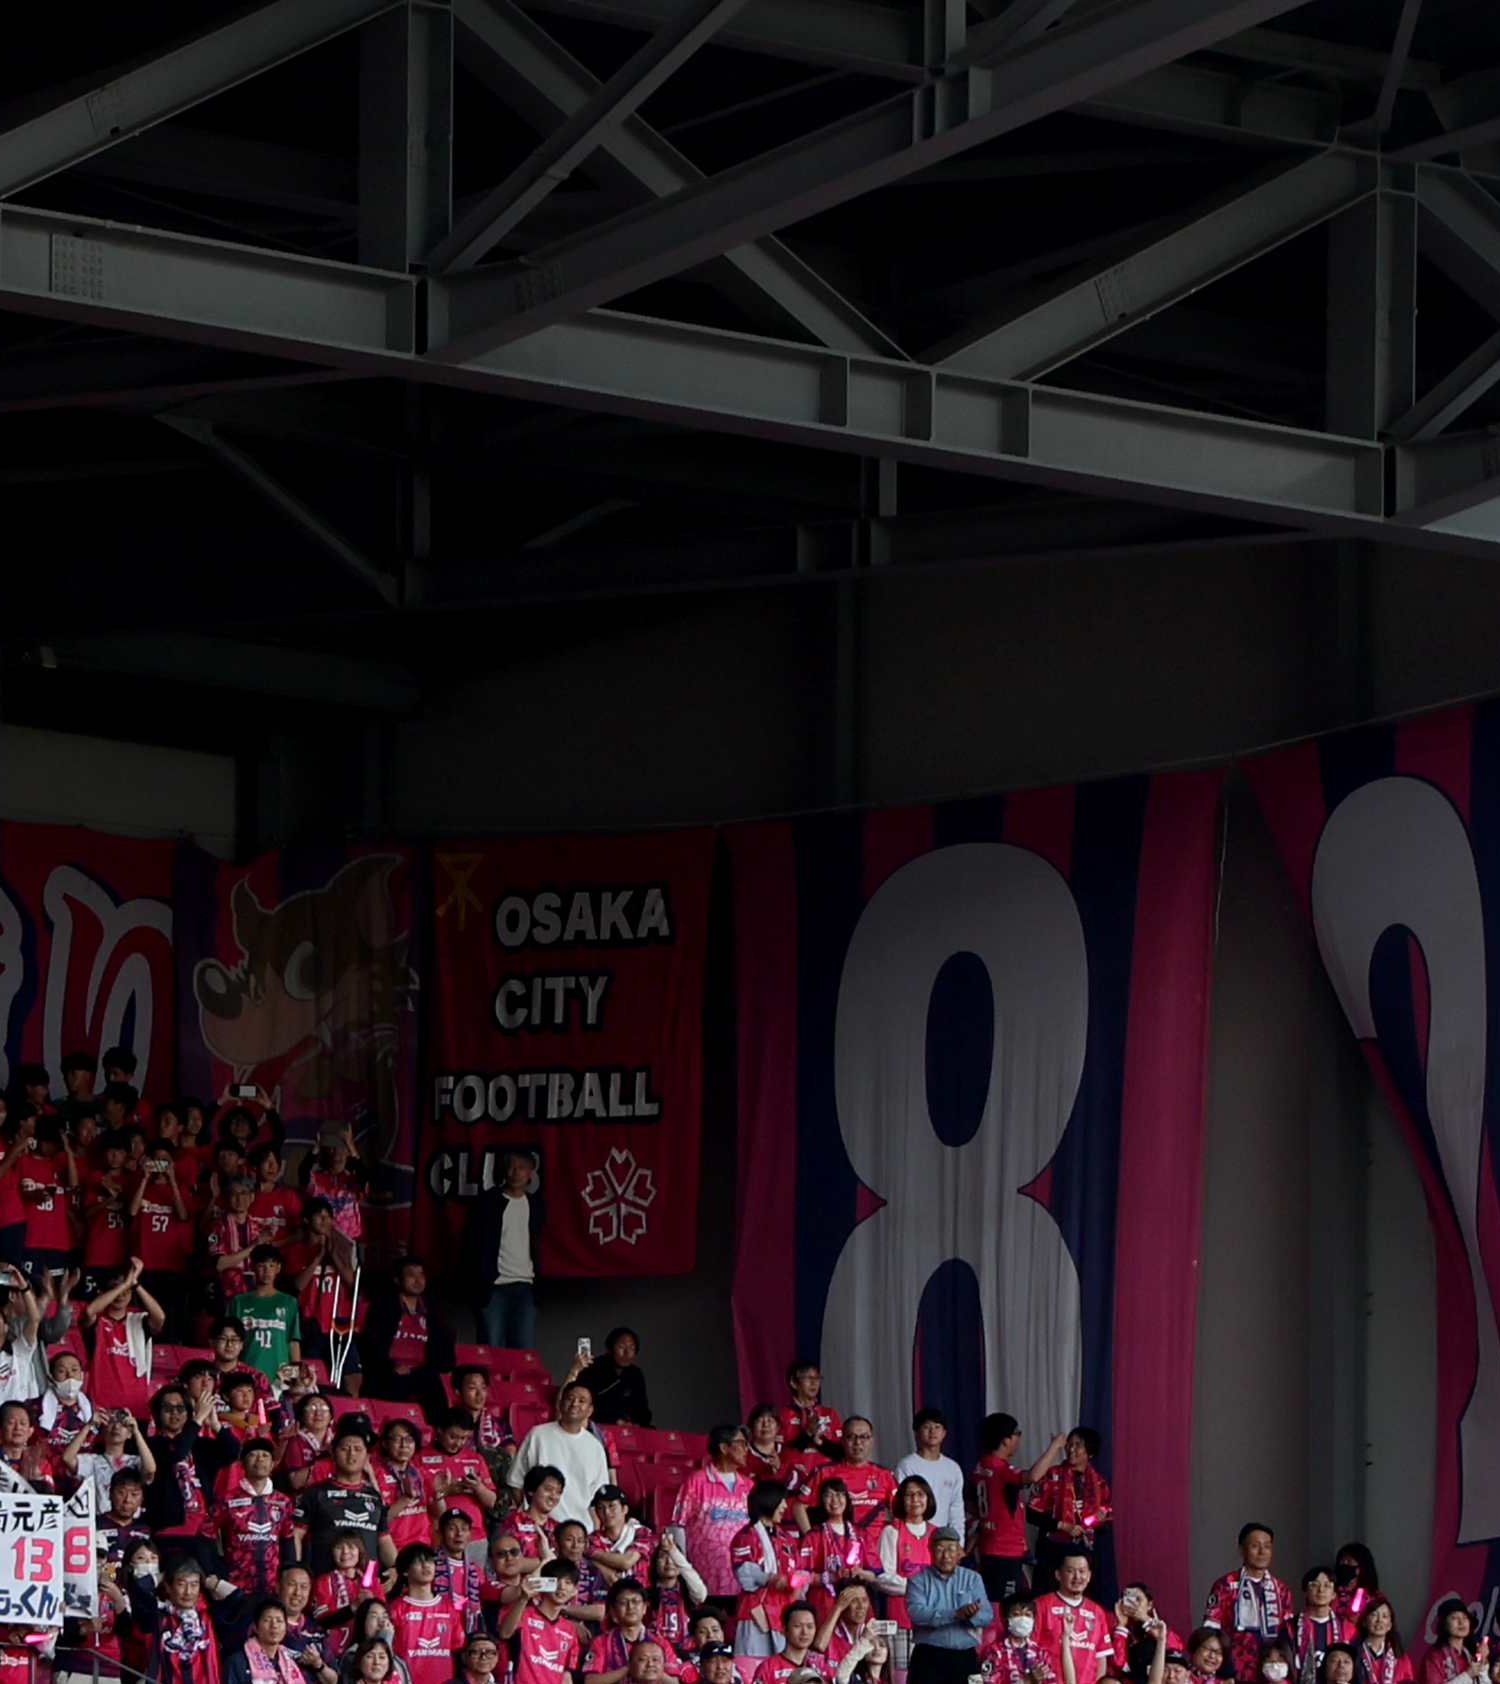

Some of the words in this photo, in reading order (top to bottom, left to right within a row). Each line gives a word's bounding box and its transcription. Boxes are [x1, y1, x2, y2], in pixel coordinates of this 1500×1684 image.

[495, 887, 674, 947] OSAKA
[494, 976, 608, 1030] CITY
[434, 1071, 660, 1125] FOOTBALL
[819, 842, 1090, 1490] 8
[11, 1535, 56, 1583] 13
